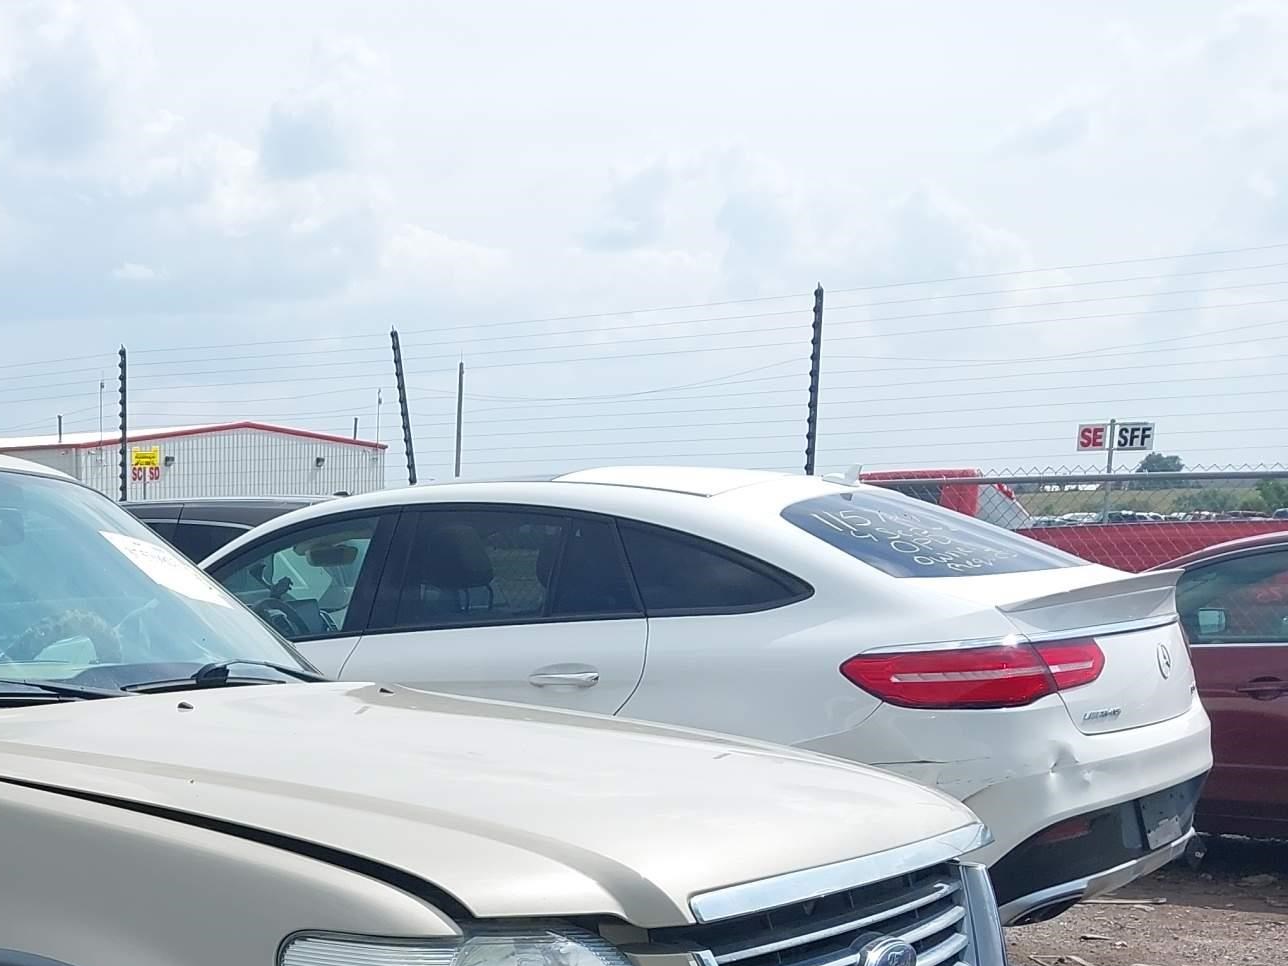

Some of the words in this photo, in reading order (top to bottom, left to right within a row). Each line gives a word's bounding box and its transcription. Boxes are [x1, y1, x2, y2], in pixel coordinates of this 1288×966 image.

[1079, 427, 1105, 447] SE
[1117, 426, 1152, 447] SFF
[132, 466, 143, 481] SC
[149, 466, 160, 480] SD
